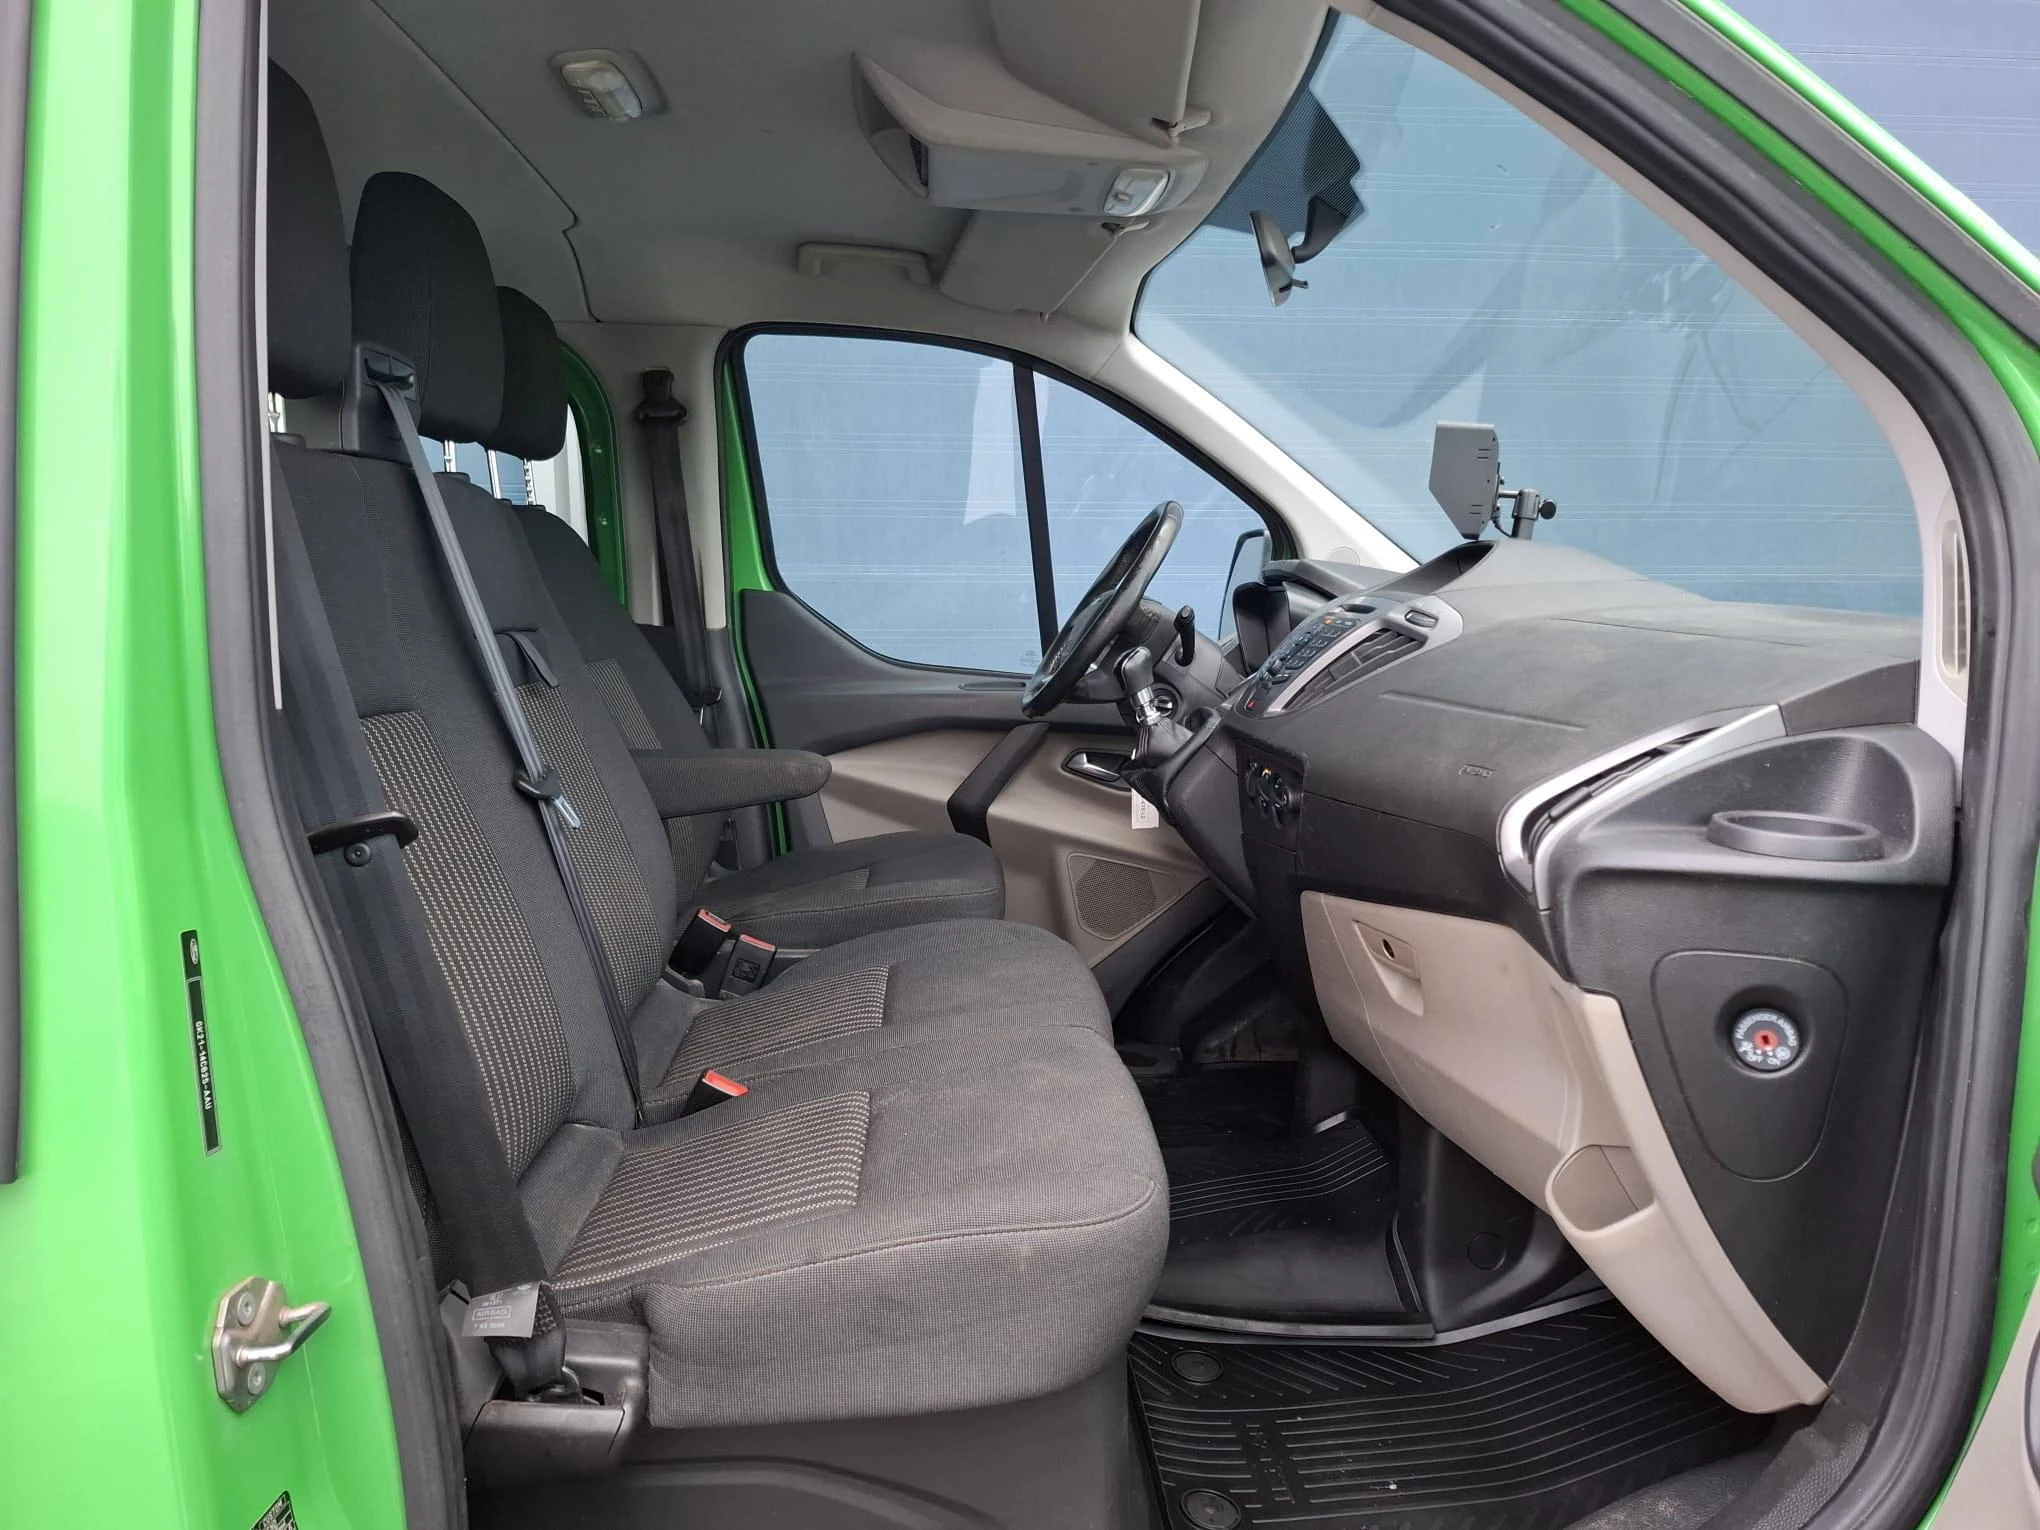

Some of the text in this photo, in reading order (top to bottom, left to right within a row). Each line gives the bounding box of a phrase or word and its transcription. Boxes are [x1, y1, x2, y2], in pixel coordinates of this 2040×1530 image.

[1735, 1013, 1797, 1047] PASSENGER AIRBAG
[1746, 1052, 1764, 1063] OFF
[1766, 1056, 1781, 1066] ON
